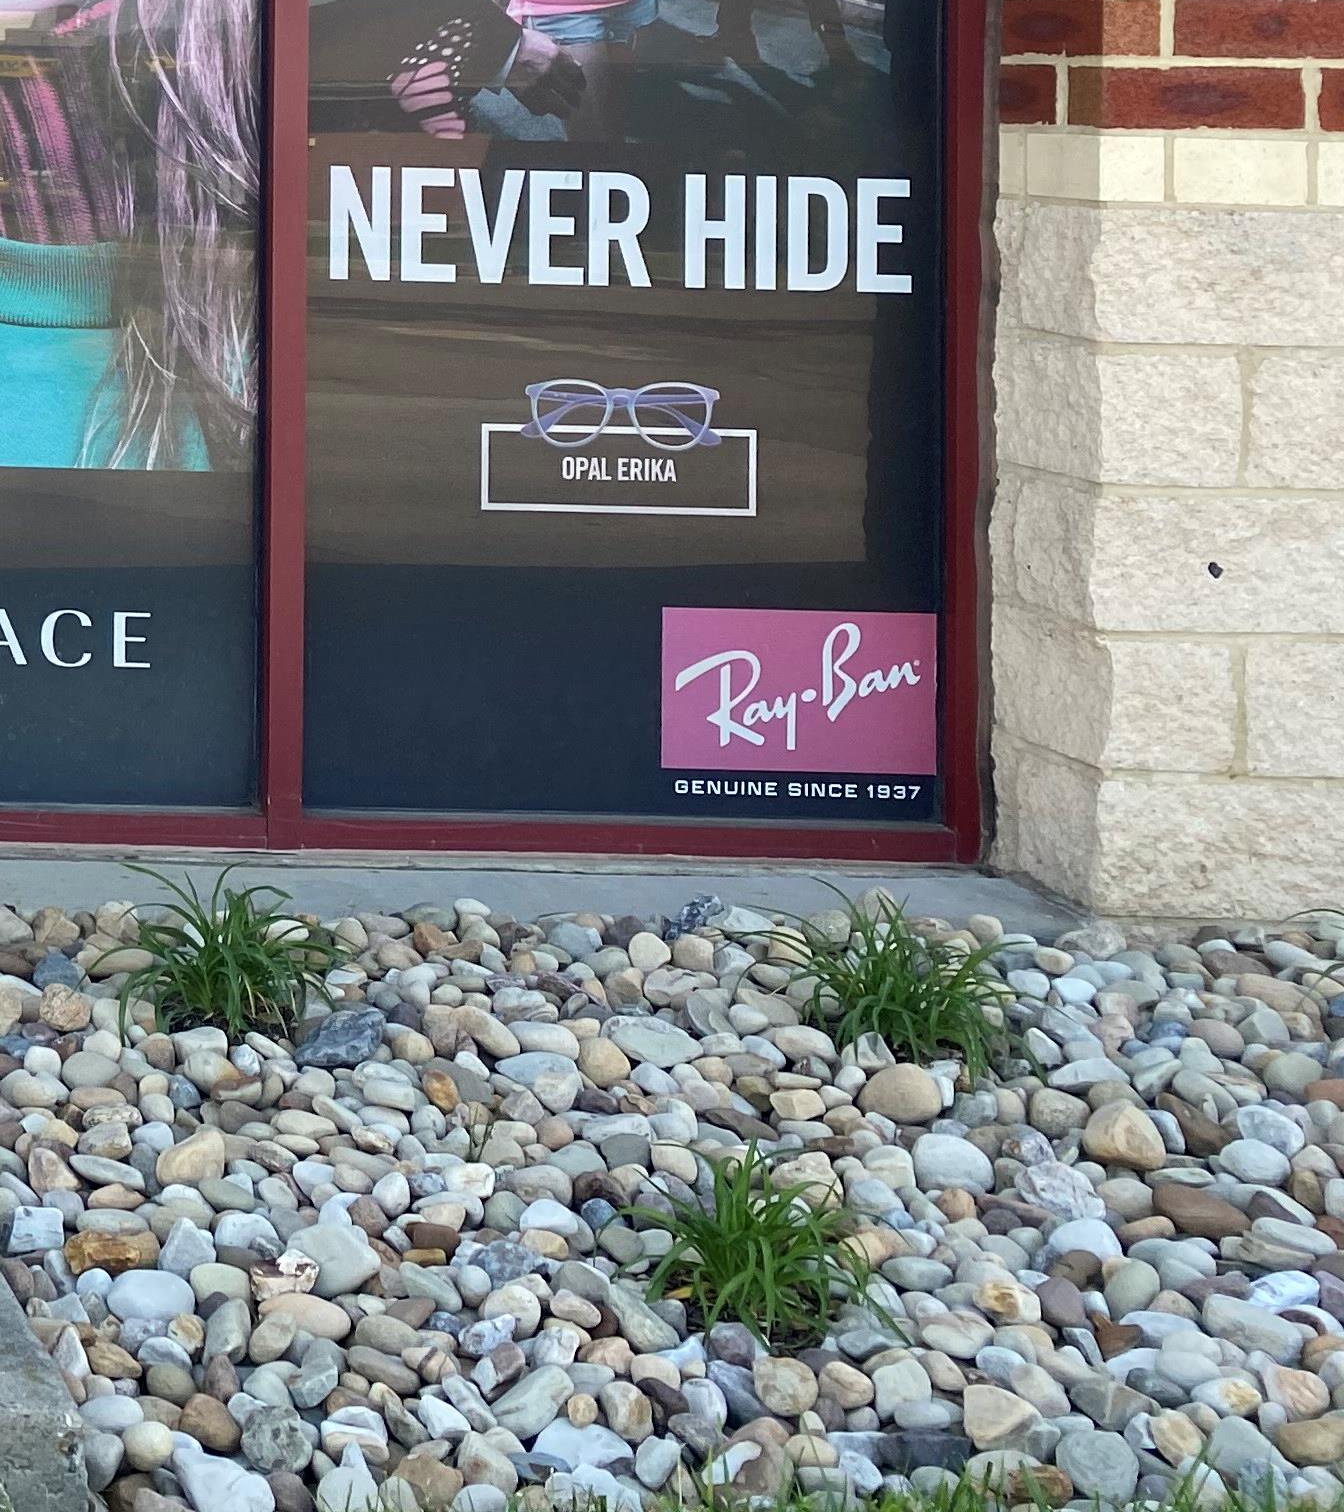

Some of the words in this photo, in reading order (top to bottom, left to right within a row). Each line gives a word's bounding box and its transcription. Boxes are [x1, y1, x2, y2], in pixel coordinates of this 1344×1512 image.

[328, 164, 653, 288] NEVER
[683, 172, 913, 294] HIDE
[561, 455, 613, 482] OPAL
[616, 456, 677, 484] ERIKA
[673, 779, 779, 798] GENUINE
[787, 781, 859, 799] SINCE
[867, 784, 922, 801] 1937
